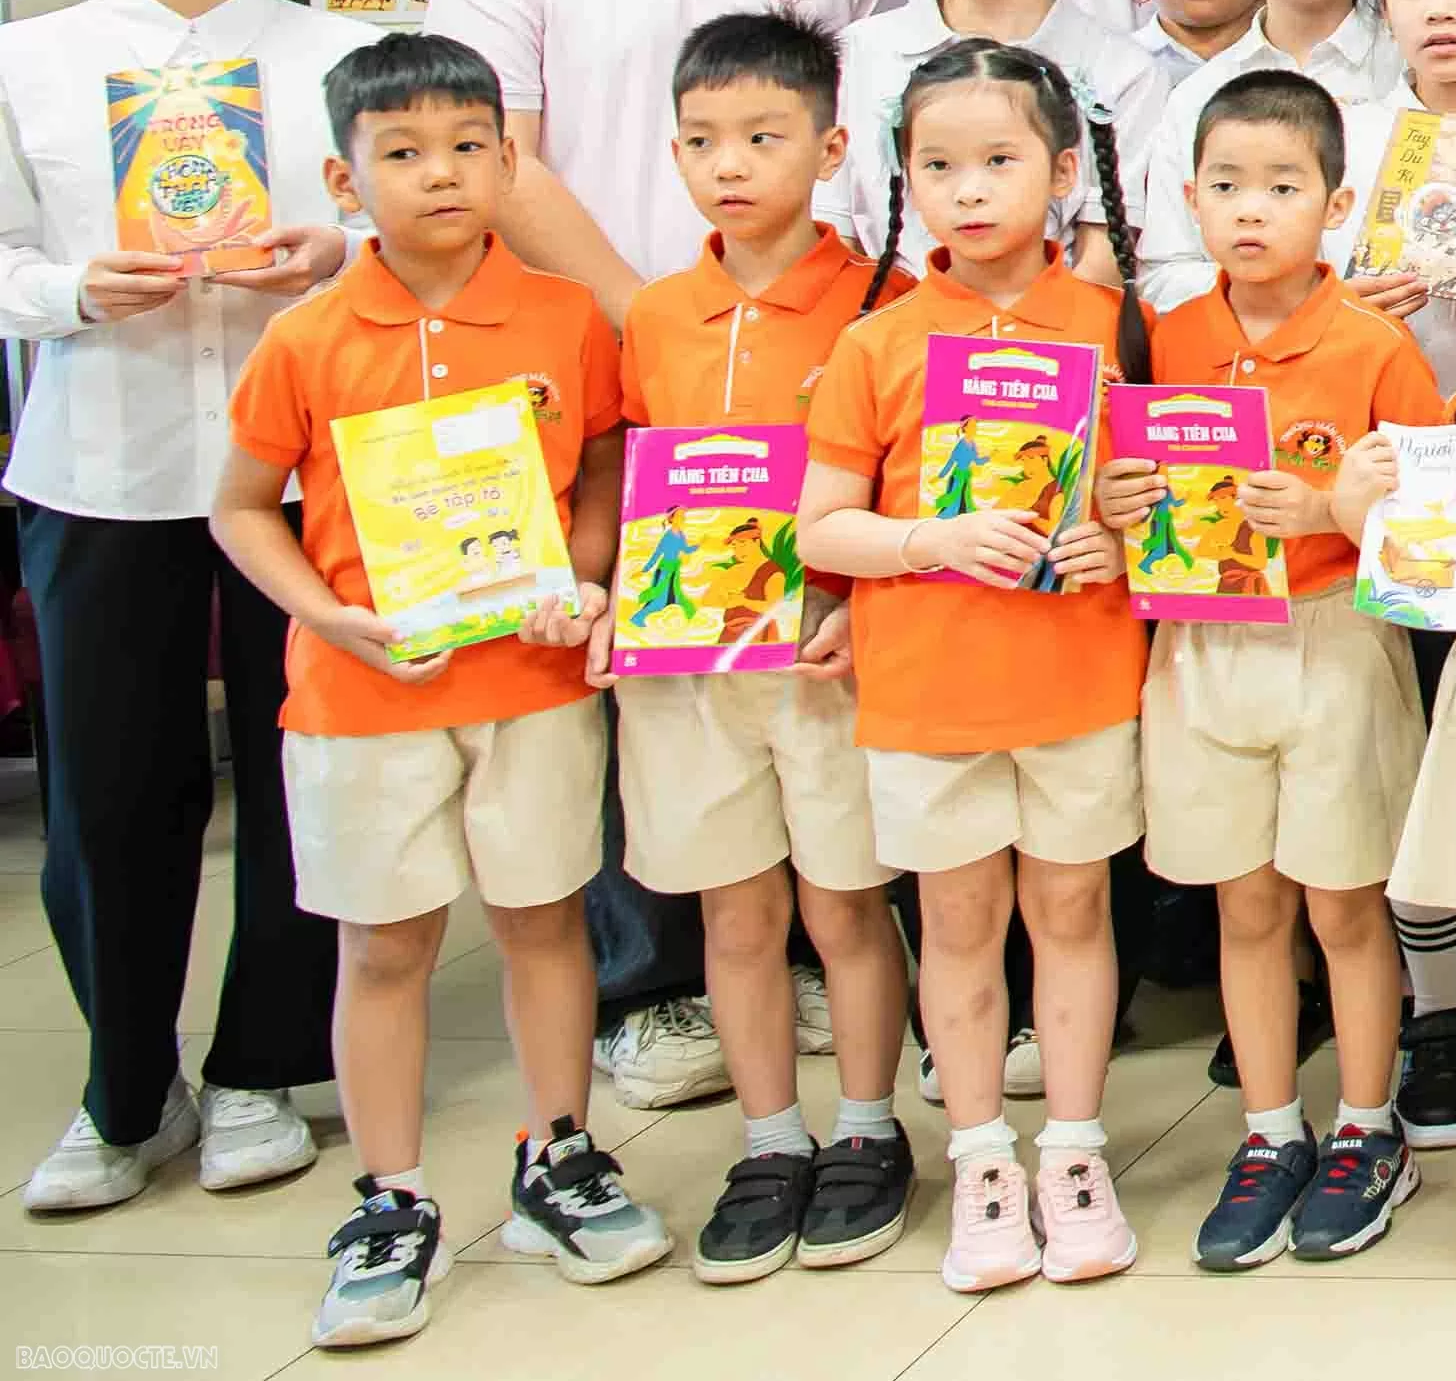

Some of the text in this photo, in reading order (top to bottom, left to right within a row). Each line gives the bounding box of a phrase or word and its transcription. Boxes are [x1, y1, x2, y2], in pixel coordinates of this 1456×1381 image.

[1028, 382, 1058, 403] CUA
[742, 467, 769, 483] CUA
[1330, 1139, 1363, 1150] BIKER
